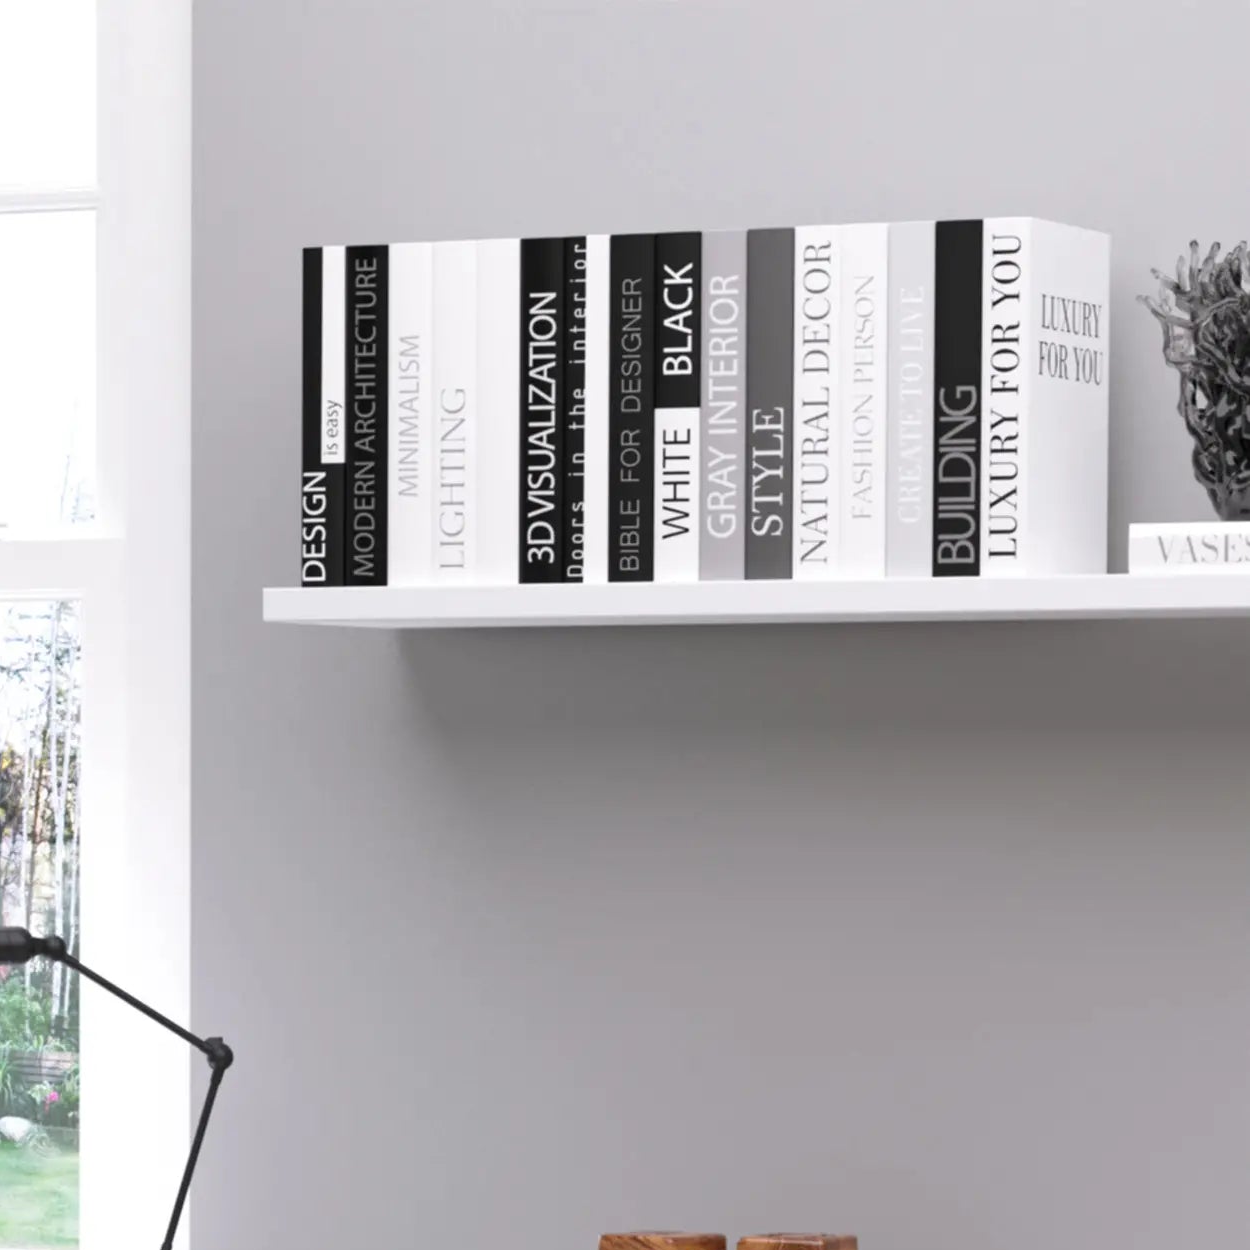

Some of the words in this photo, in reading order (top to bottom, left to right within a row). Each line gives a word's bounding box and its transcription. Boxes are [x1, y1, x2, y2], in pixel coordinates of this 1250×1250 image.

[569, 242, 586, 363] interior
[662, 261, 693, 375] BLACK
[802, 239, 831, 373] DECOR
[900, 284, 925, 350] LIVE
[991, 233, 1022, 309] YOU
[1041, 294, 1102, 338] LUXURY
[355, 256, 377, 452] ARCHITECTURE
[621, 276, 642, 412] DESIGNER
[708, 273, 739, 434] INTERIOR
[853, 274, 875, 383] PERSON
[900, 362, 923, 399] TO
[989, 319, 1020, 395] FOR
[1038, 341, 1069, 380] FOR
[1073, 347, 1103, 386] YOU
[324, 442, 338, 454] is
[326, 399, 342, 437] easy
[398, 334, 420, 496] MINIMALISM
[528, 291, 557, 517] VISUALIZATION
[568, 387, 586, 429] the
[621, 428, 641, 481] FOR
[851, 392, 873, 518] FASHION
[353, 460, 376, 576] MODERN
[438, 386, 466, 568] LIGHTING
[568, 452, 585, 476] in
[662, 427, 691, 539] WHITE
[707, 445, 737, 538] GRAY
[751, 405, 784, 536] STYLE
[800, 385, 830, 563] NATURAL
[898, 407, 923, 522] CREATE
[937, 384, 977, 563] BUILDING
[988, 408, 1019, 558] LUXURY
[302, 470, 326, 581] DESIGN
[527, 521, 555, 562] 3D
[567, 499, 584, 577] Doors
[620, 498, 640, 571] BIBLE
